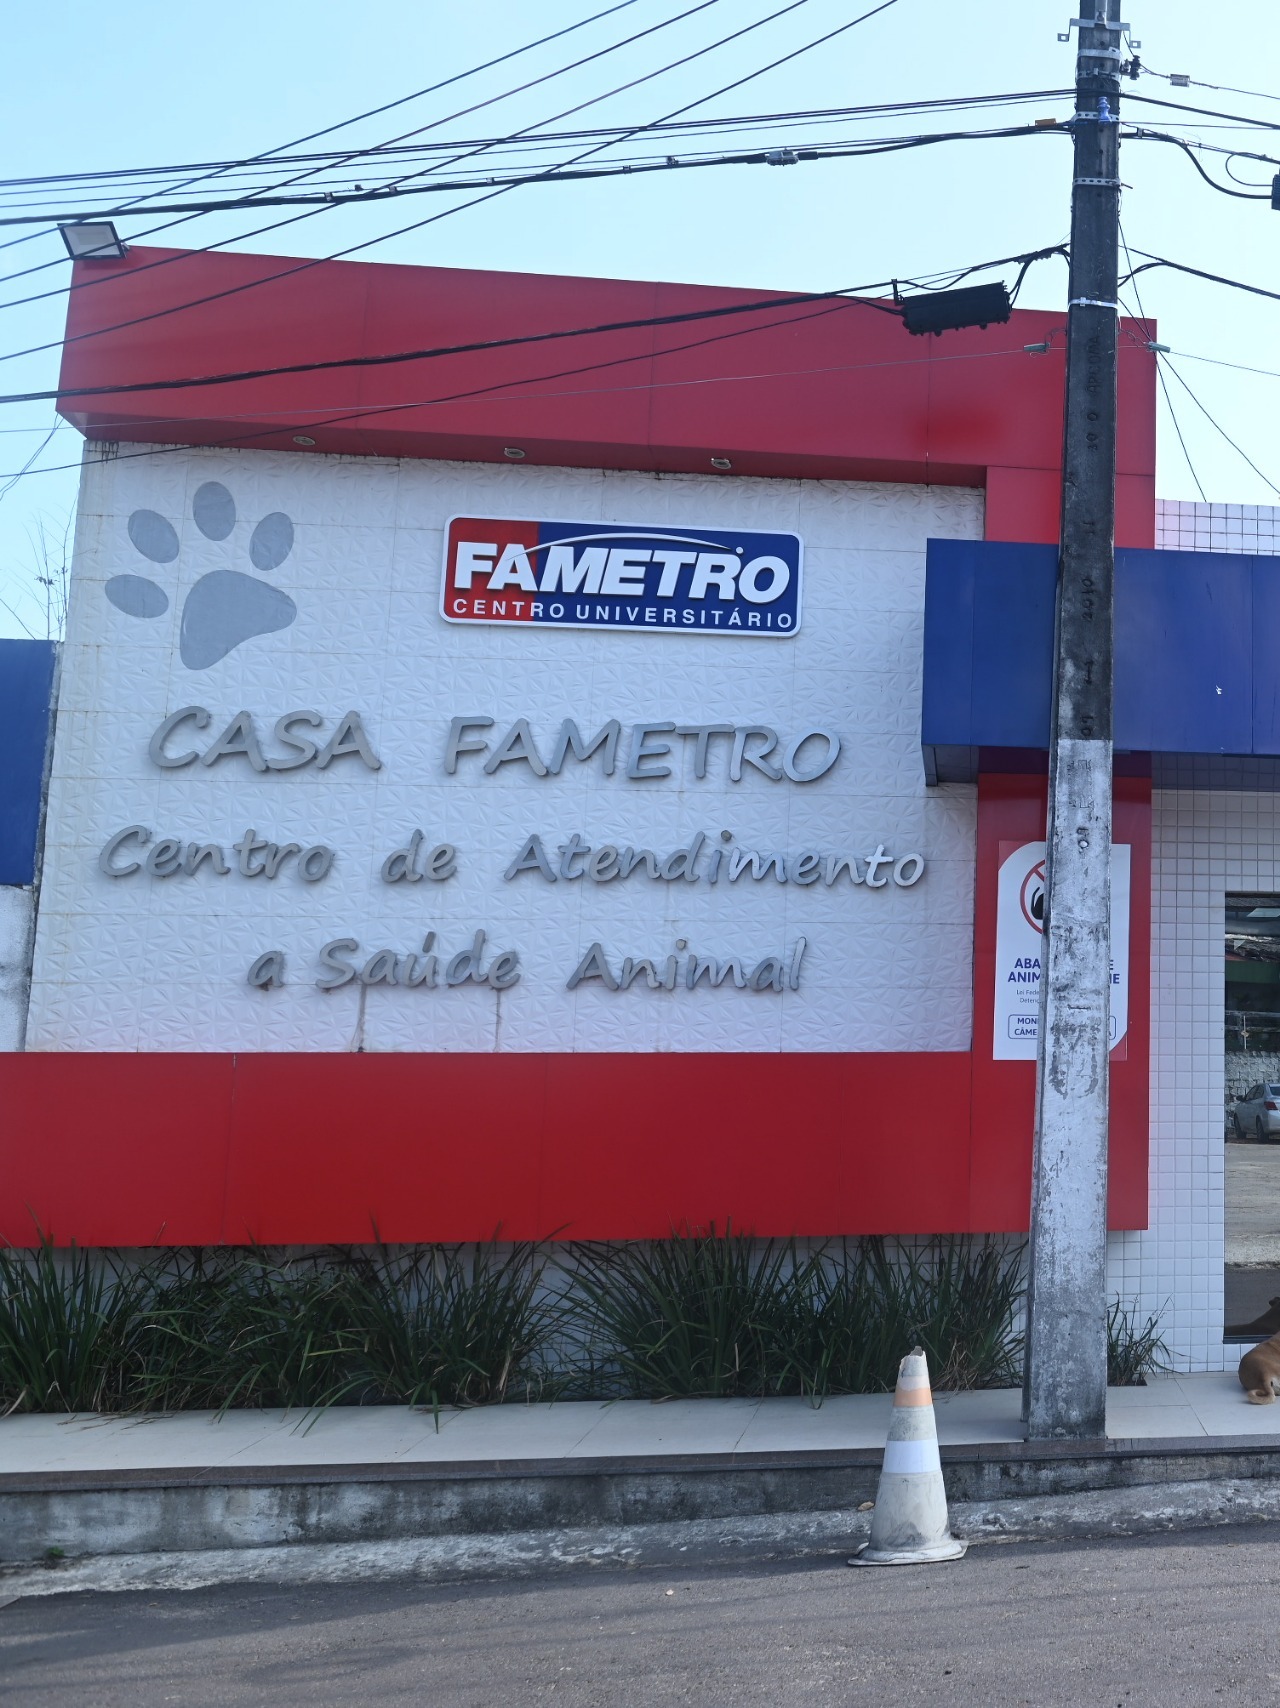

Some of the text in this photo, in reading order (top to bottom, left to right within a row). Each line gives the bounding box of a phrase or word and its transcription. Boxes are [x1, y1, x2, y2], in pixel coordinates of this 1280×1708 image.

[453, 541, 791, 604] FAMETRO
[452, 598, 793, 629] CENTRO UNIVERSITÁRIO
[147, 705, 841, 784] CASA FAMETRO
[98, 824, 925, 891] Centro de Atendimento
[245, 928, 807, 993] a Saúde Animal
[1007, 971, 1041, 983] ANIM
[1014, 1026, 1038, 1036] CÂME
